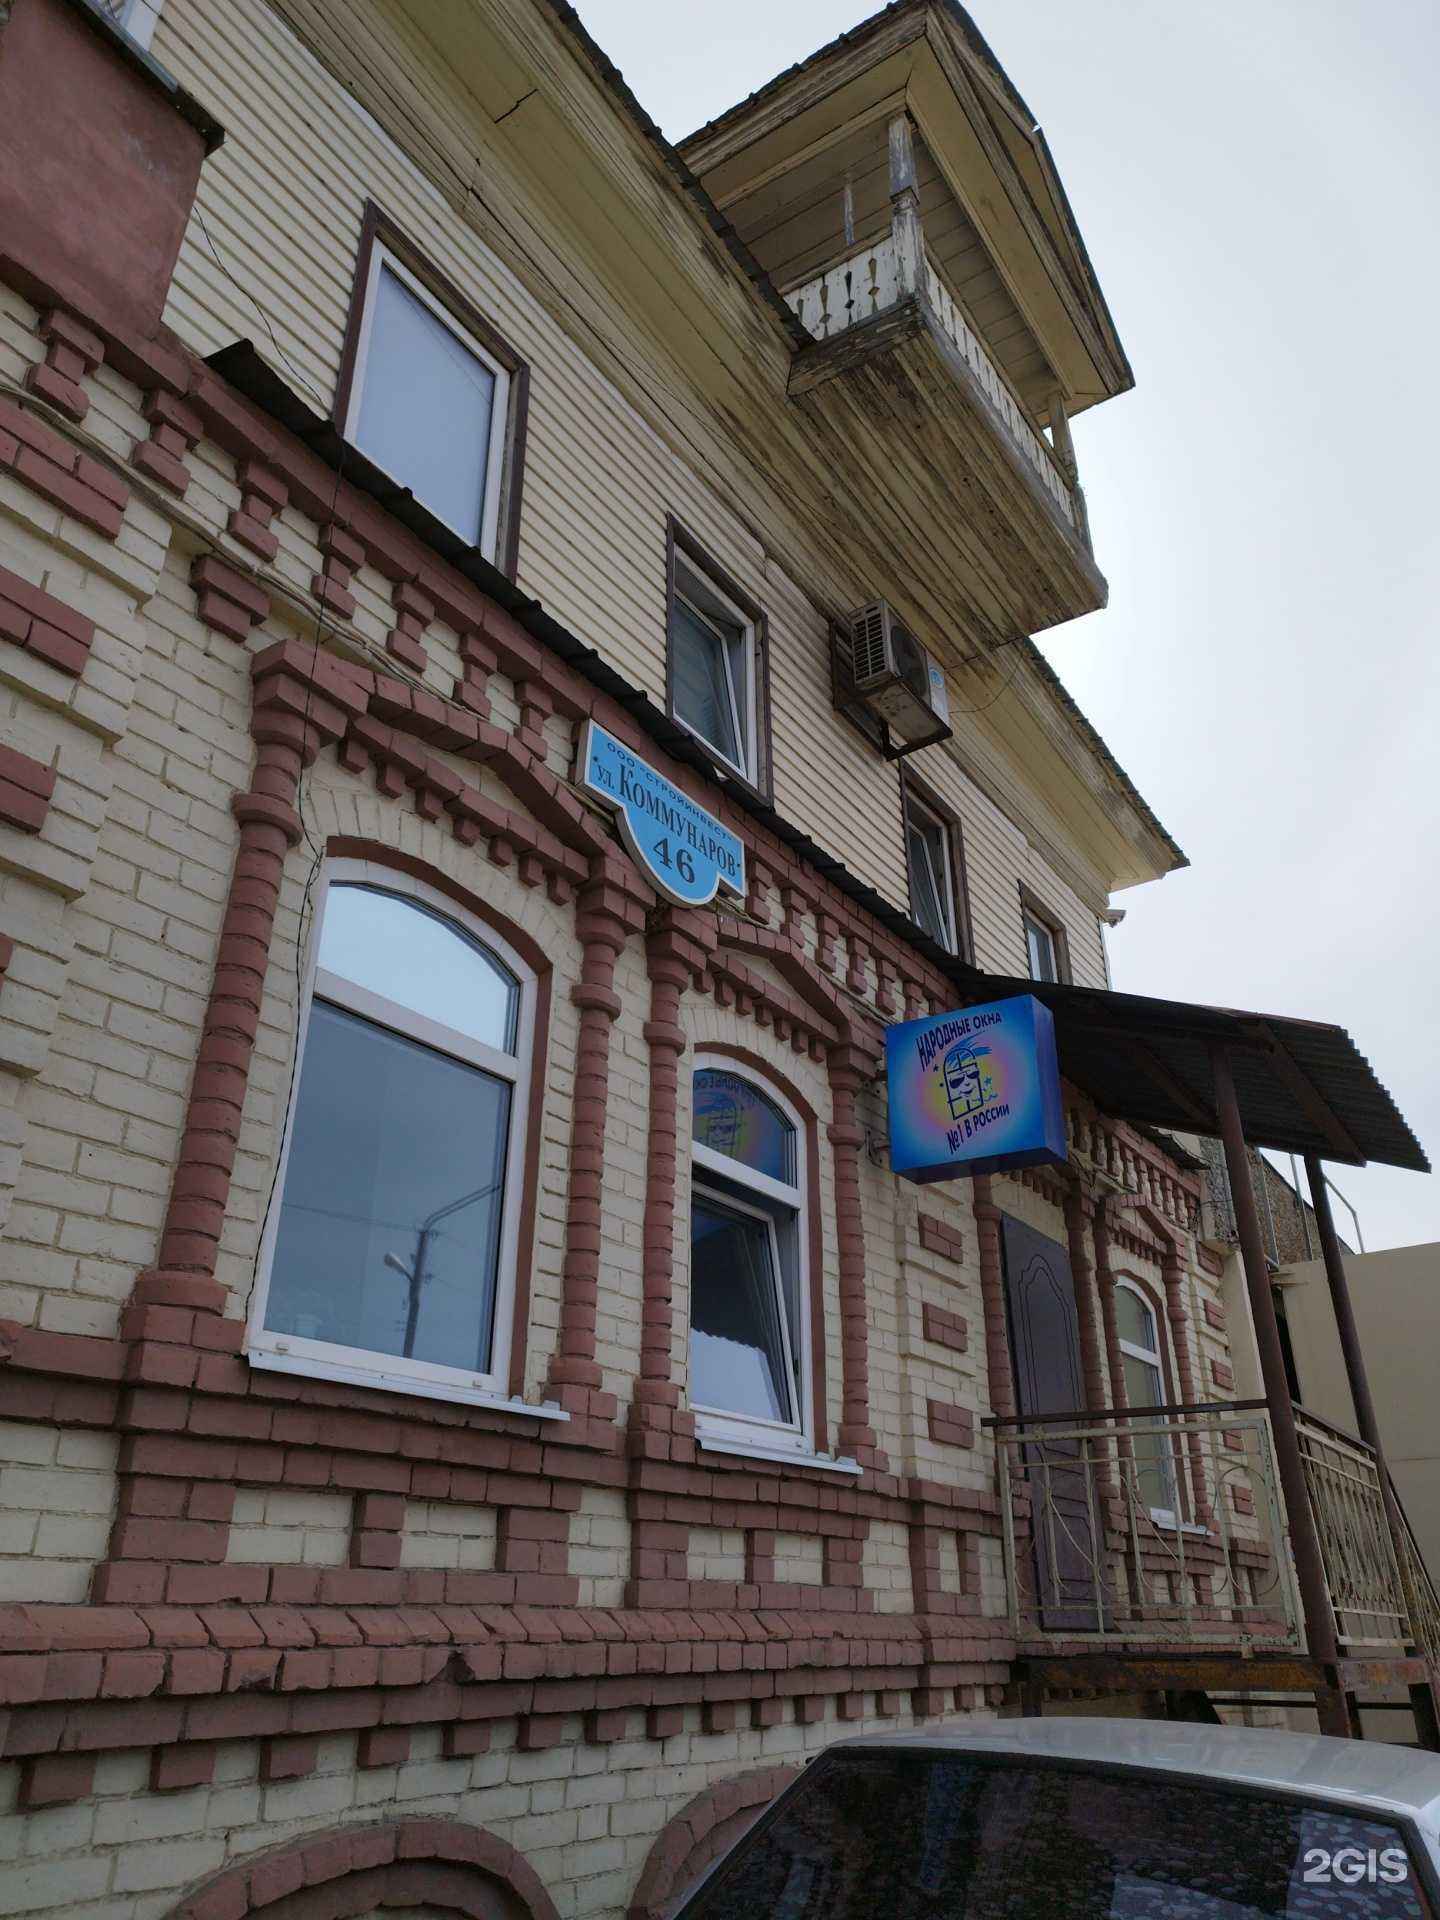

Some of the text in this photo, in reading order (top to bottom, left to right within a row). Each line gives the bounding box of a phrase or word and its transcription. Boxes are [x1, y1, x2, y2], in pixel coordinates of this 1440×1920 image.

[607, 742, 635, 767] ООО
[620, 764, 735, 877] КОММУНАРОВ
[653, 838, 695, 883] 46
[916, 1012, 1002, 1072] НАРОДНЫЕ ОКНА
[945, 1104, 1010, 1154] №1 В РОССИИ
